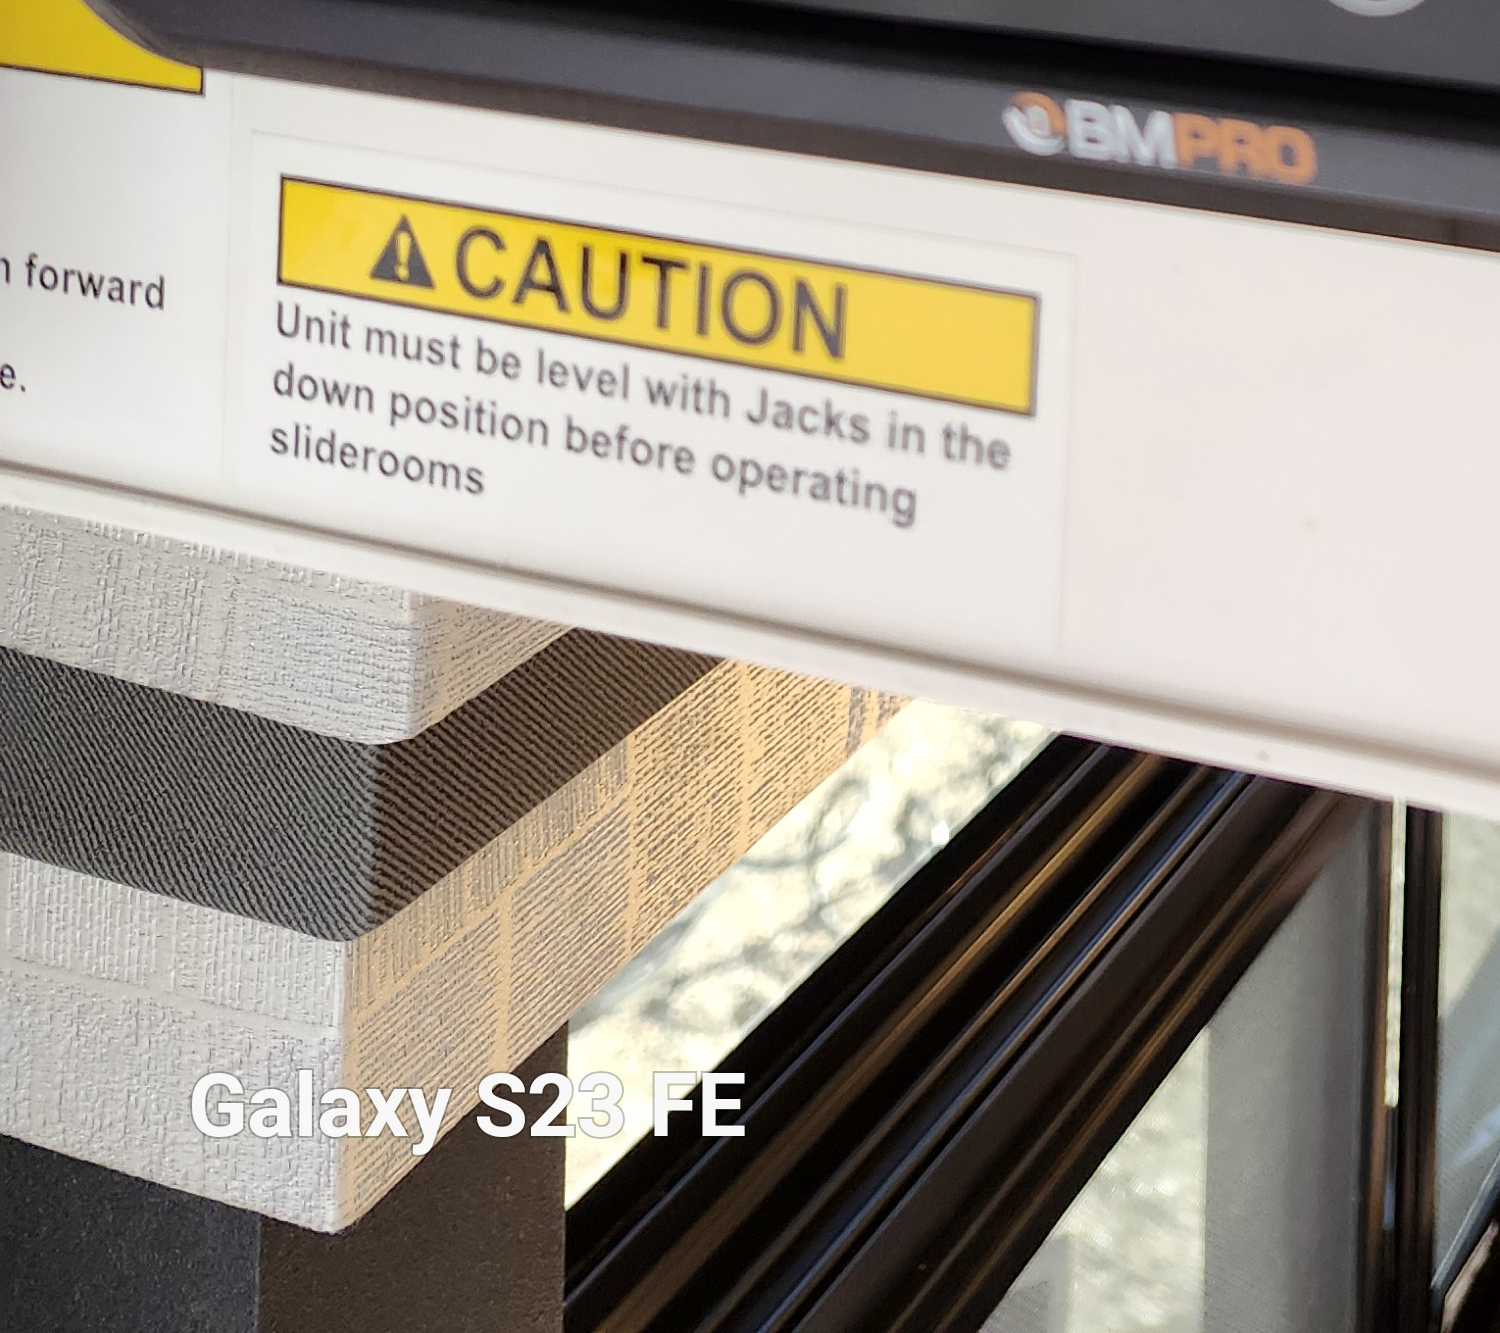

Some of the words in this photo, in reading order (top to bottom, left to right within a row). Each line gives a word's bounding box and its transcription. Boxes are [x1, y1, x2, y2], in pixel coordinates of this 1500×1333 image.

[1064, 97, 1319, 185] BMPRO
[25, 252, 165, 311] forward
[455, 224, 849, 362] CAUTION
[276, 299, 351, 351] Unit
[364, 323, 461, 370] must
[475, 336, 522, 380] be
[536, 348, 630, 400] level
[644, 372, 731, 419] with
[745, 386, 871, 446] Jacks
[886, 410, 926, 454] in
[942, 419, 1012, 471] the
[269, 424, 486, 496] sliderooms
[272, 361, 375, 414] down
[389, 389, 550, 448] position
[564, 413, 697, 476] before
[710, 450, 918, 530] operating
